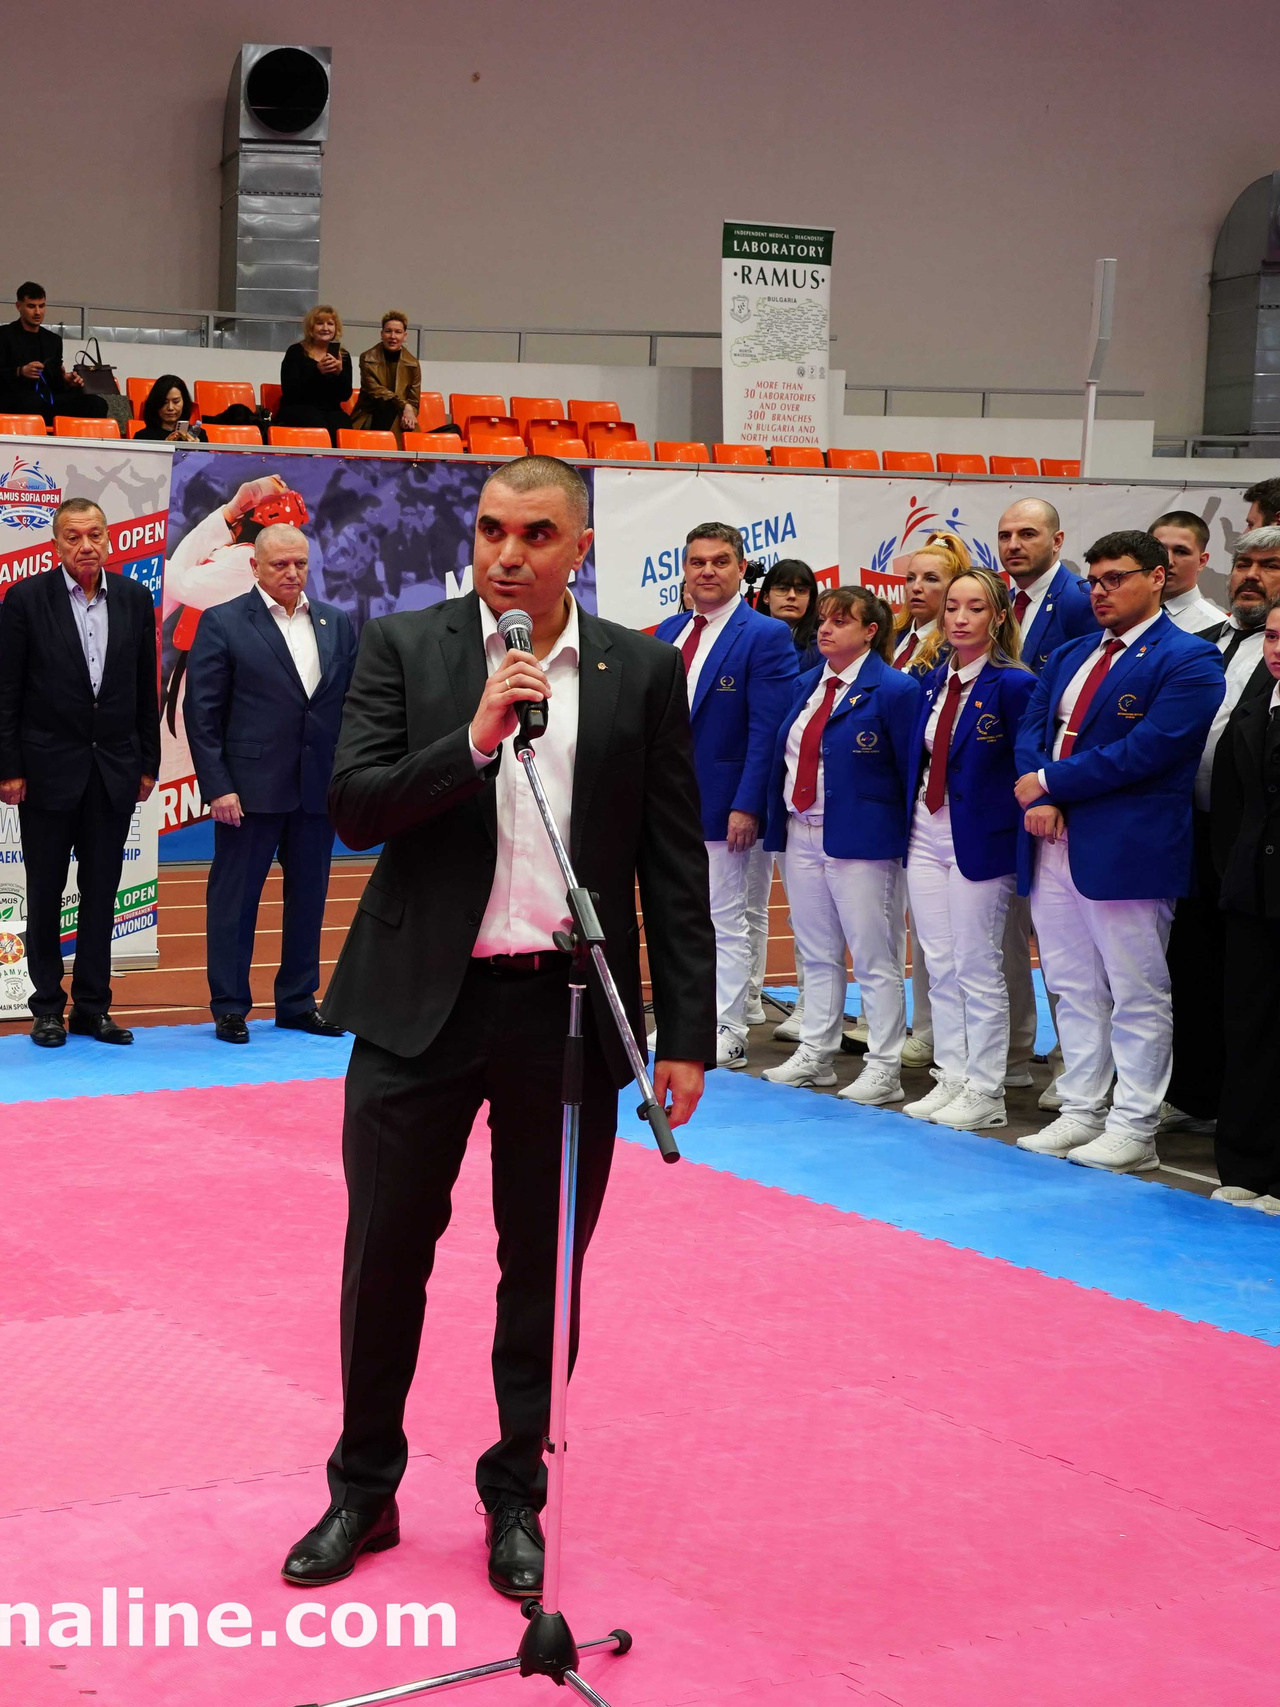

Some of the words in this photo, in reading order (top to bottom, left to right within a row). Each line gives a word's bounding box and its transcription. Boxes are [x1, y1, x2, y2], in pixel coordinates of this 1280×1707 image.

[733, 240, 825, 257] LABORATORY
[756, 381, 778, 389] MORE
[782, 382, 803, 390] THAN
[744, 388, 755, 399] 30
[759, 392, 816, 402] LABORATORIES
[759, 402, 776, 410] AND
[780, 403, 800, 411] OVER
[747, 410, 765, 420] 300
[772, 413, 812, 423] BRANCHES
[756, 424, 795, 432] BULGARIA
[741, 433, 768, 442] NORTH
[772, 435, 819, 444] MACEDONIA
[20, 492, 40, 502] SOFIA
[41, 493, 59, 503] OPEN
[22, 516, 31, 524] G2
[118, 519, 165, 551] OPEN
[151, 557, 158, 576] 7
[123, 884, 155, 907] OPEN
